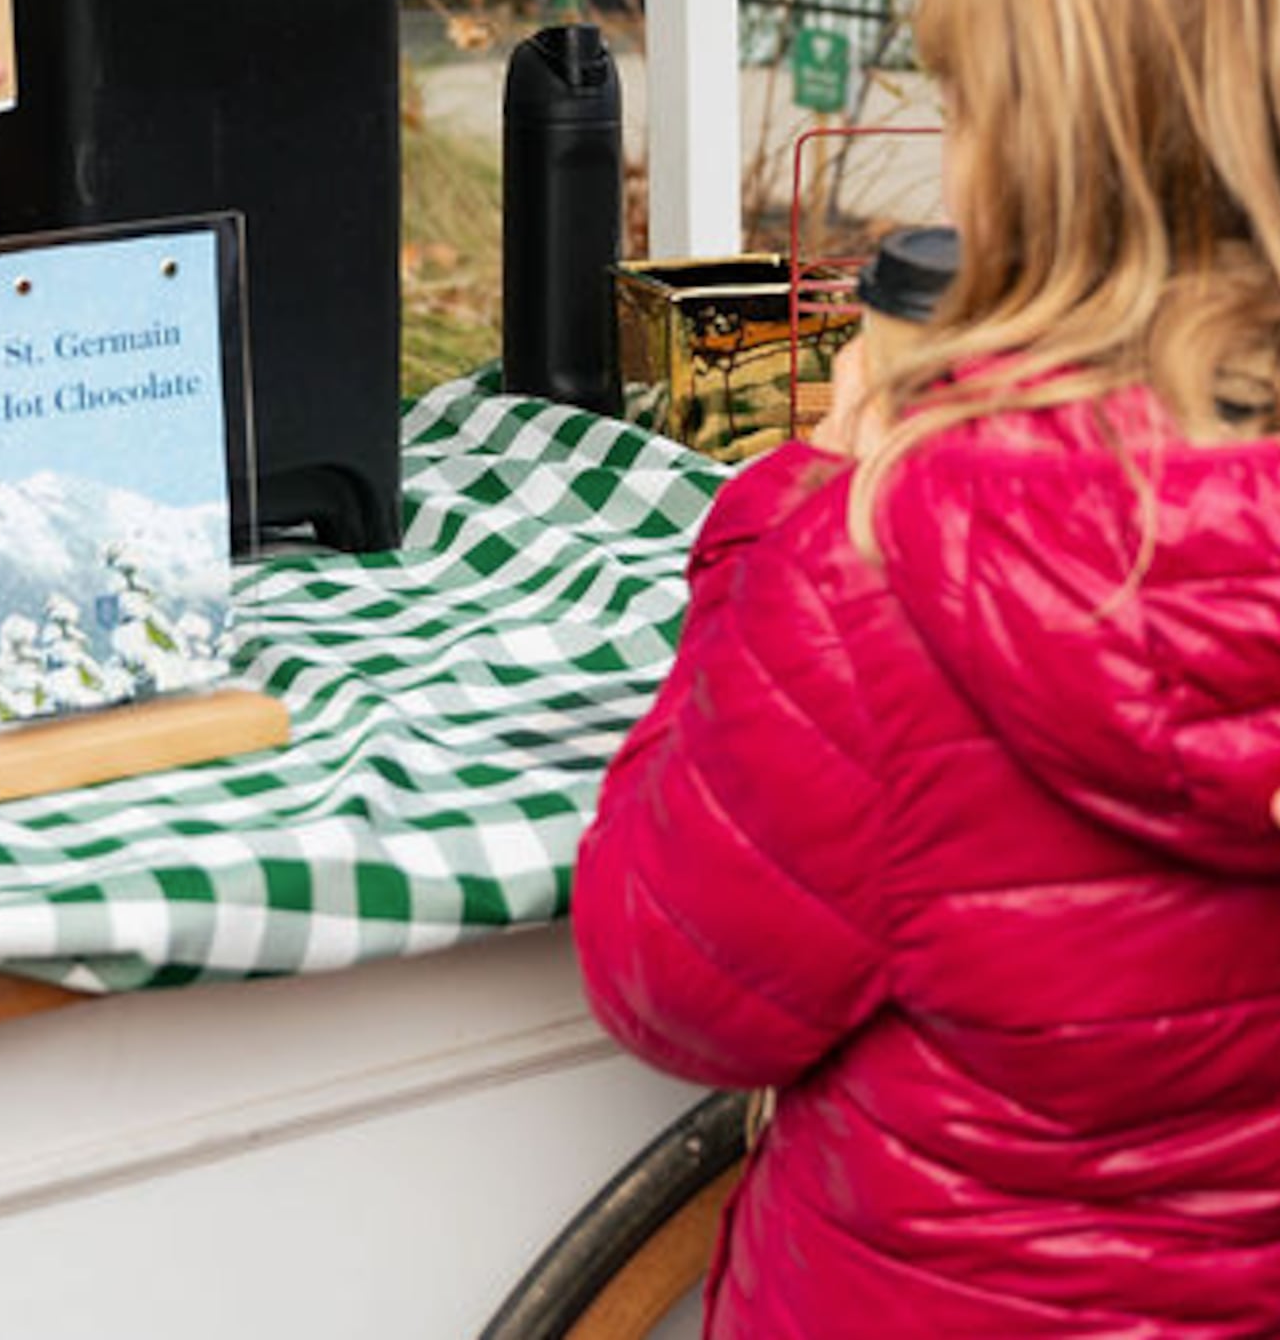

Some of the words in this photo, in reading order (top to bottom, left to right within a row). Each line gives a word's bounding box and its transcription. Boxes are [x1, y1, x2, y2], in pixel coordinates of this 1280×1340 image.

[4, 341, 43, 365] St.
[54, 321, 180, 358] Germain
[54, 372, 201, 413] Chocolate
